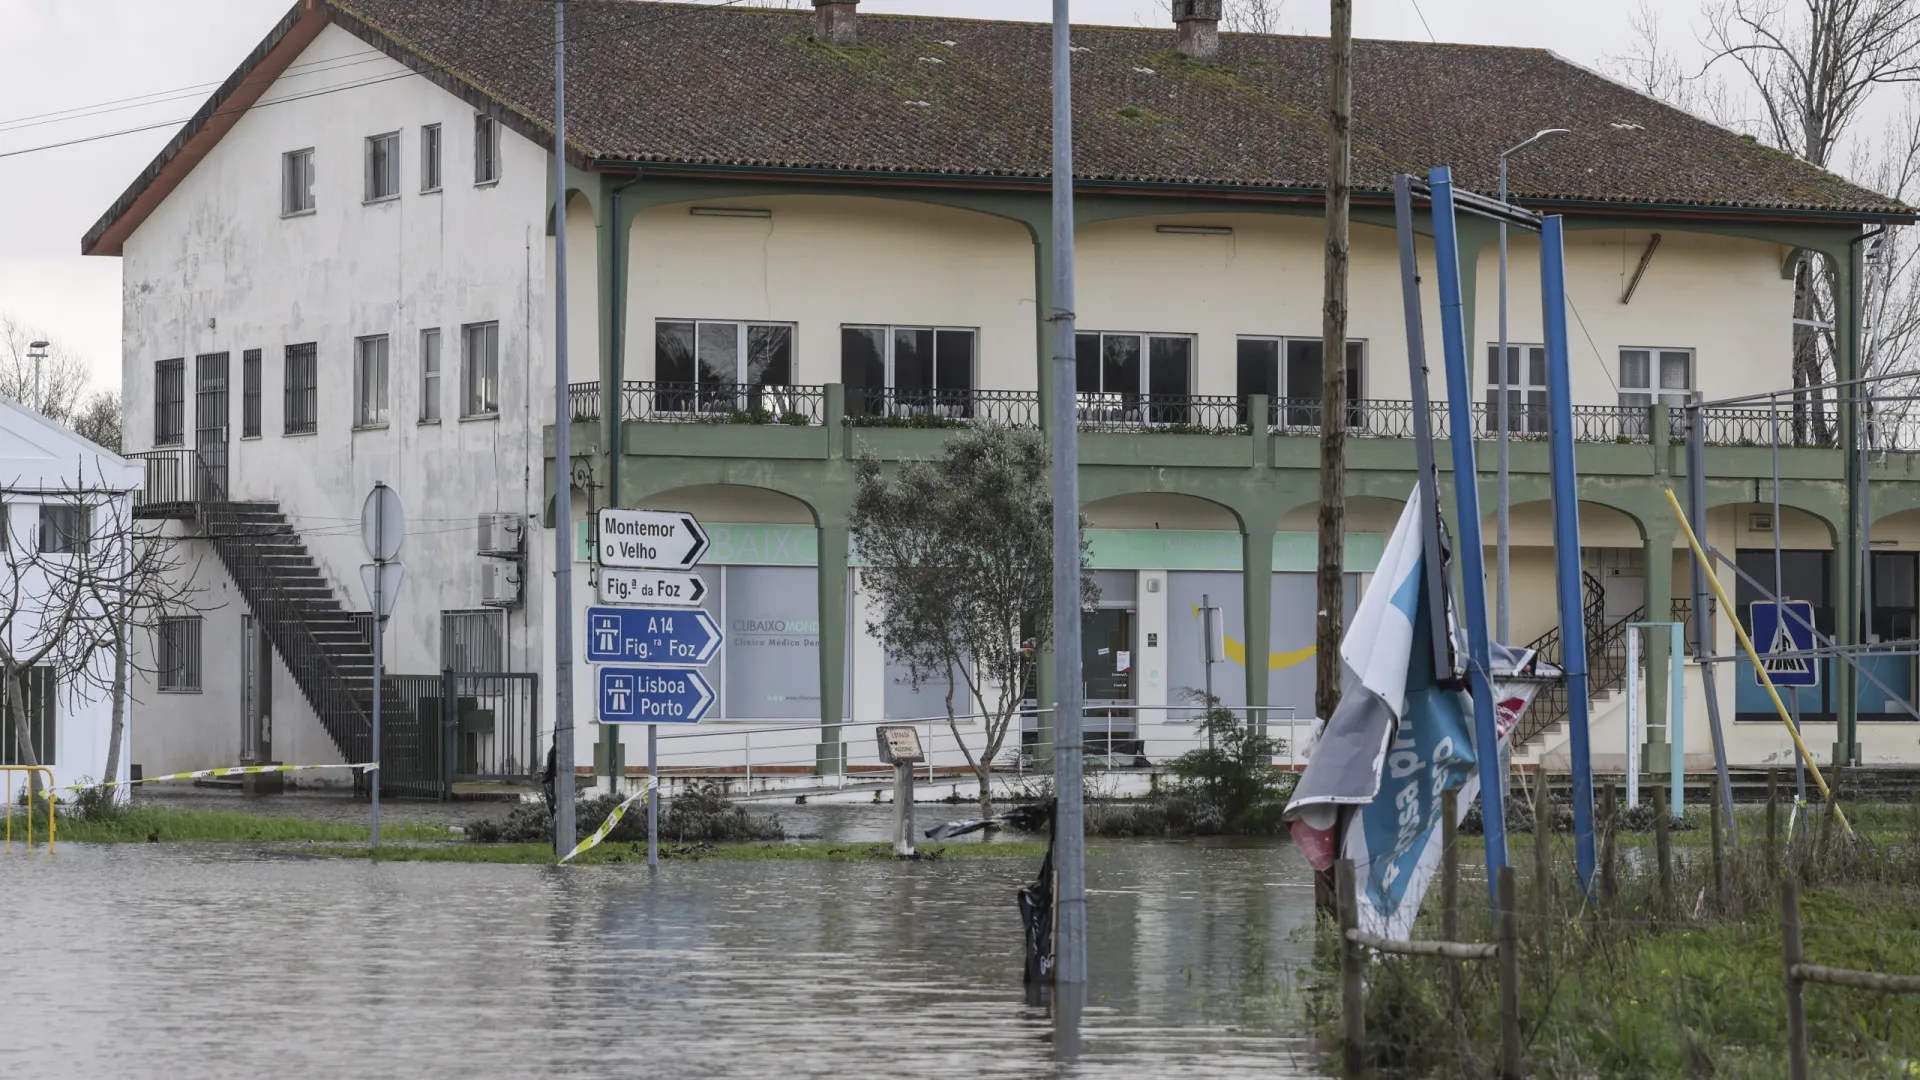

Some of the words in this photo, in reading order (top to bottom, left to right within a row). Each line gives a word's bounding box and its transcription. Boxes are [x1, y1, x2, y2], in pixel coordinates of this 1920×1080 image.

[605, 517, 675, 537] Montemor
[606, 544, 615, 557] o
[619, 541, 656, 559] Velho
[641, 584, 653, 596] da
[657, 580, 680, 597] Foz
[669, 639, 696, 657] Foz
[637, 676, 685, 694] Lisboa
[641, 698, 683, 716] Porto
